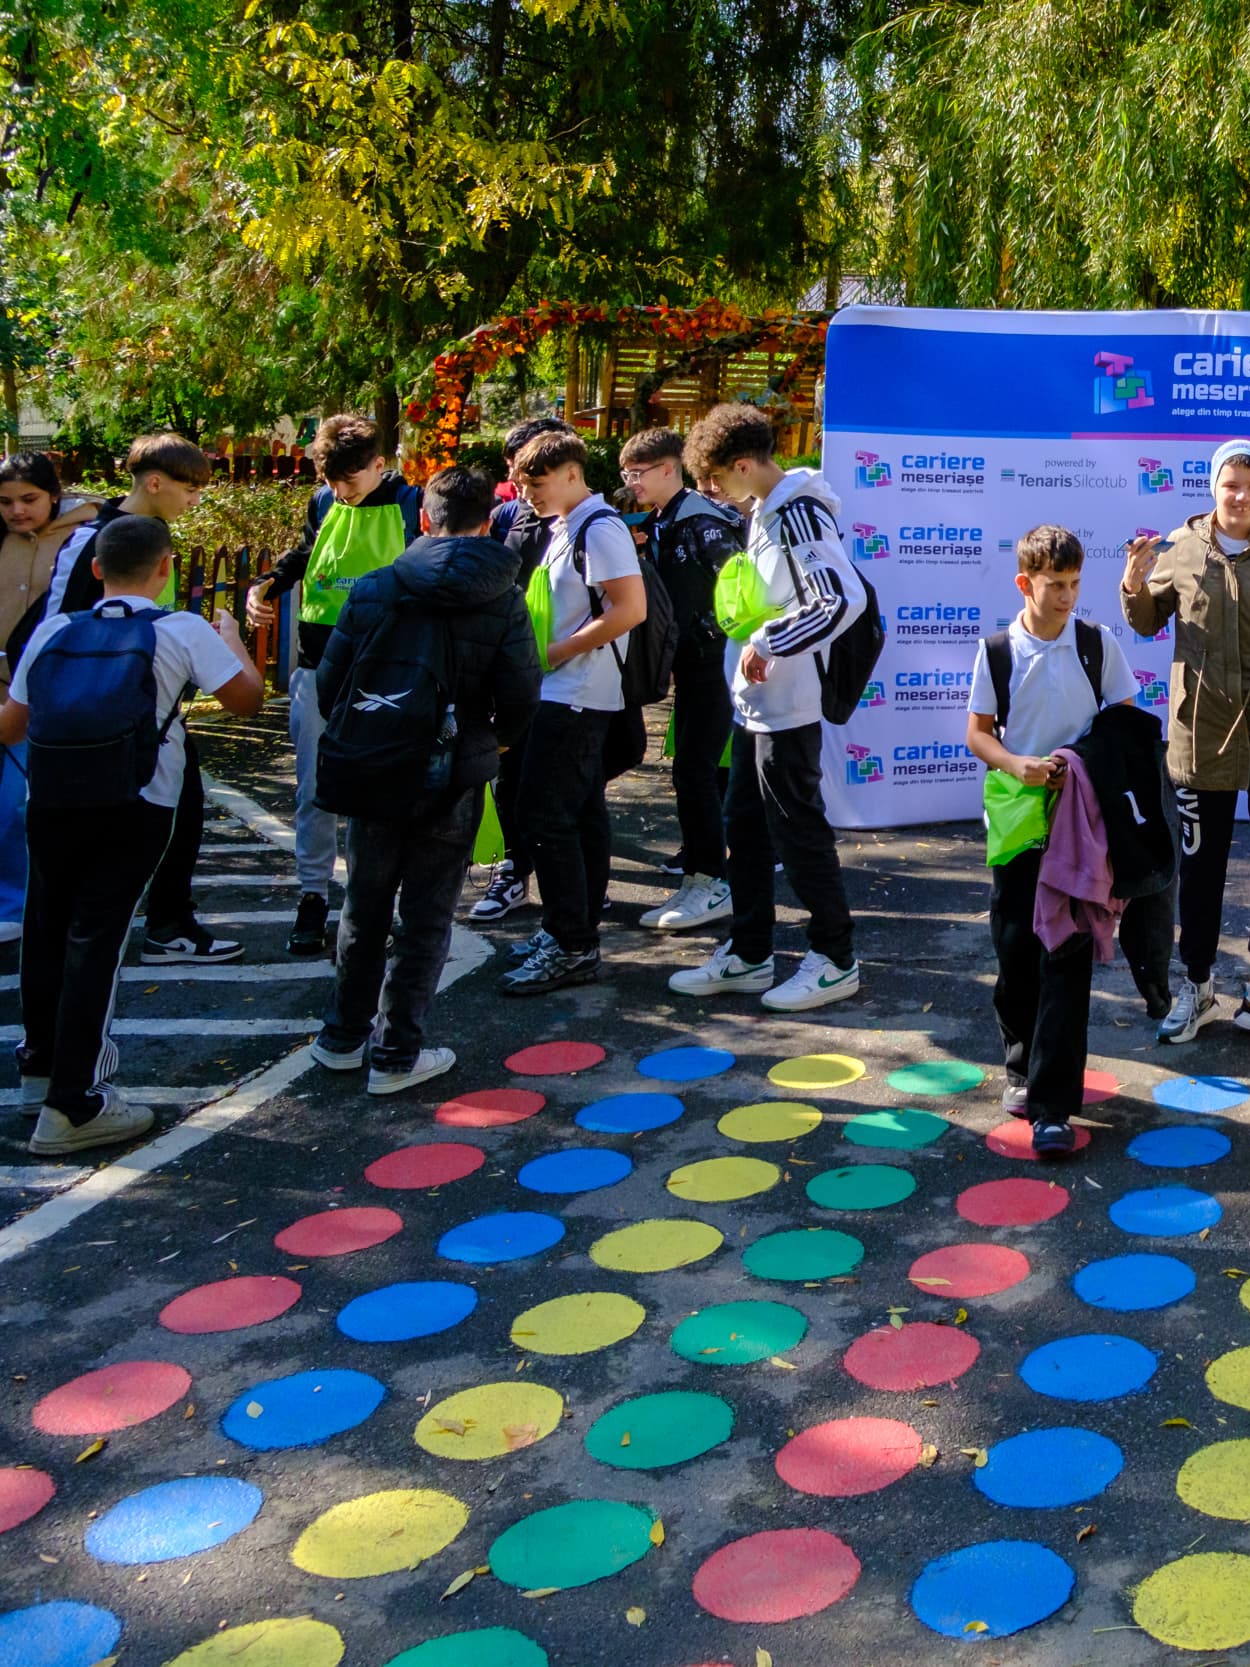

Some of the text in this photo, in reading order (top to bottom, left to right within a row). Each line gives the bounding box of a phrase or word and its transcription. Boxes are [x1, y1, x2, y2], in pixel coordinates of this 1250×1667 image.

[1196, 407, 1211, 416] din
[1213, 408, 1232, 418] timp
[901, 452, 985, 470] cariere
[1044, 458, 1096, 469] powered by
[901, 471, 985, 487] meseriașe
[899, 523, 983, 541] cariere
[1083, 528, 1094, 539] by
[899, 543, 983, 558] meseriașe
[897, 603, 981, 621] cariere
[896, 622, 980, 638] meseriașe
[895, 688, 969, 703] meseriaș
[892, 760, 977, 776] meseriașe
